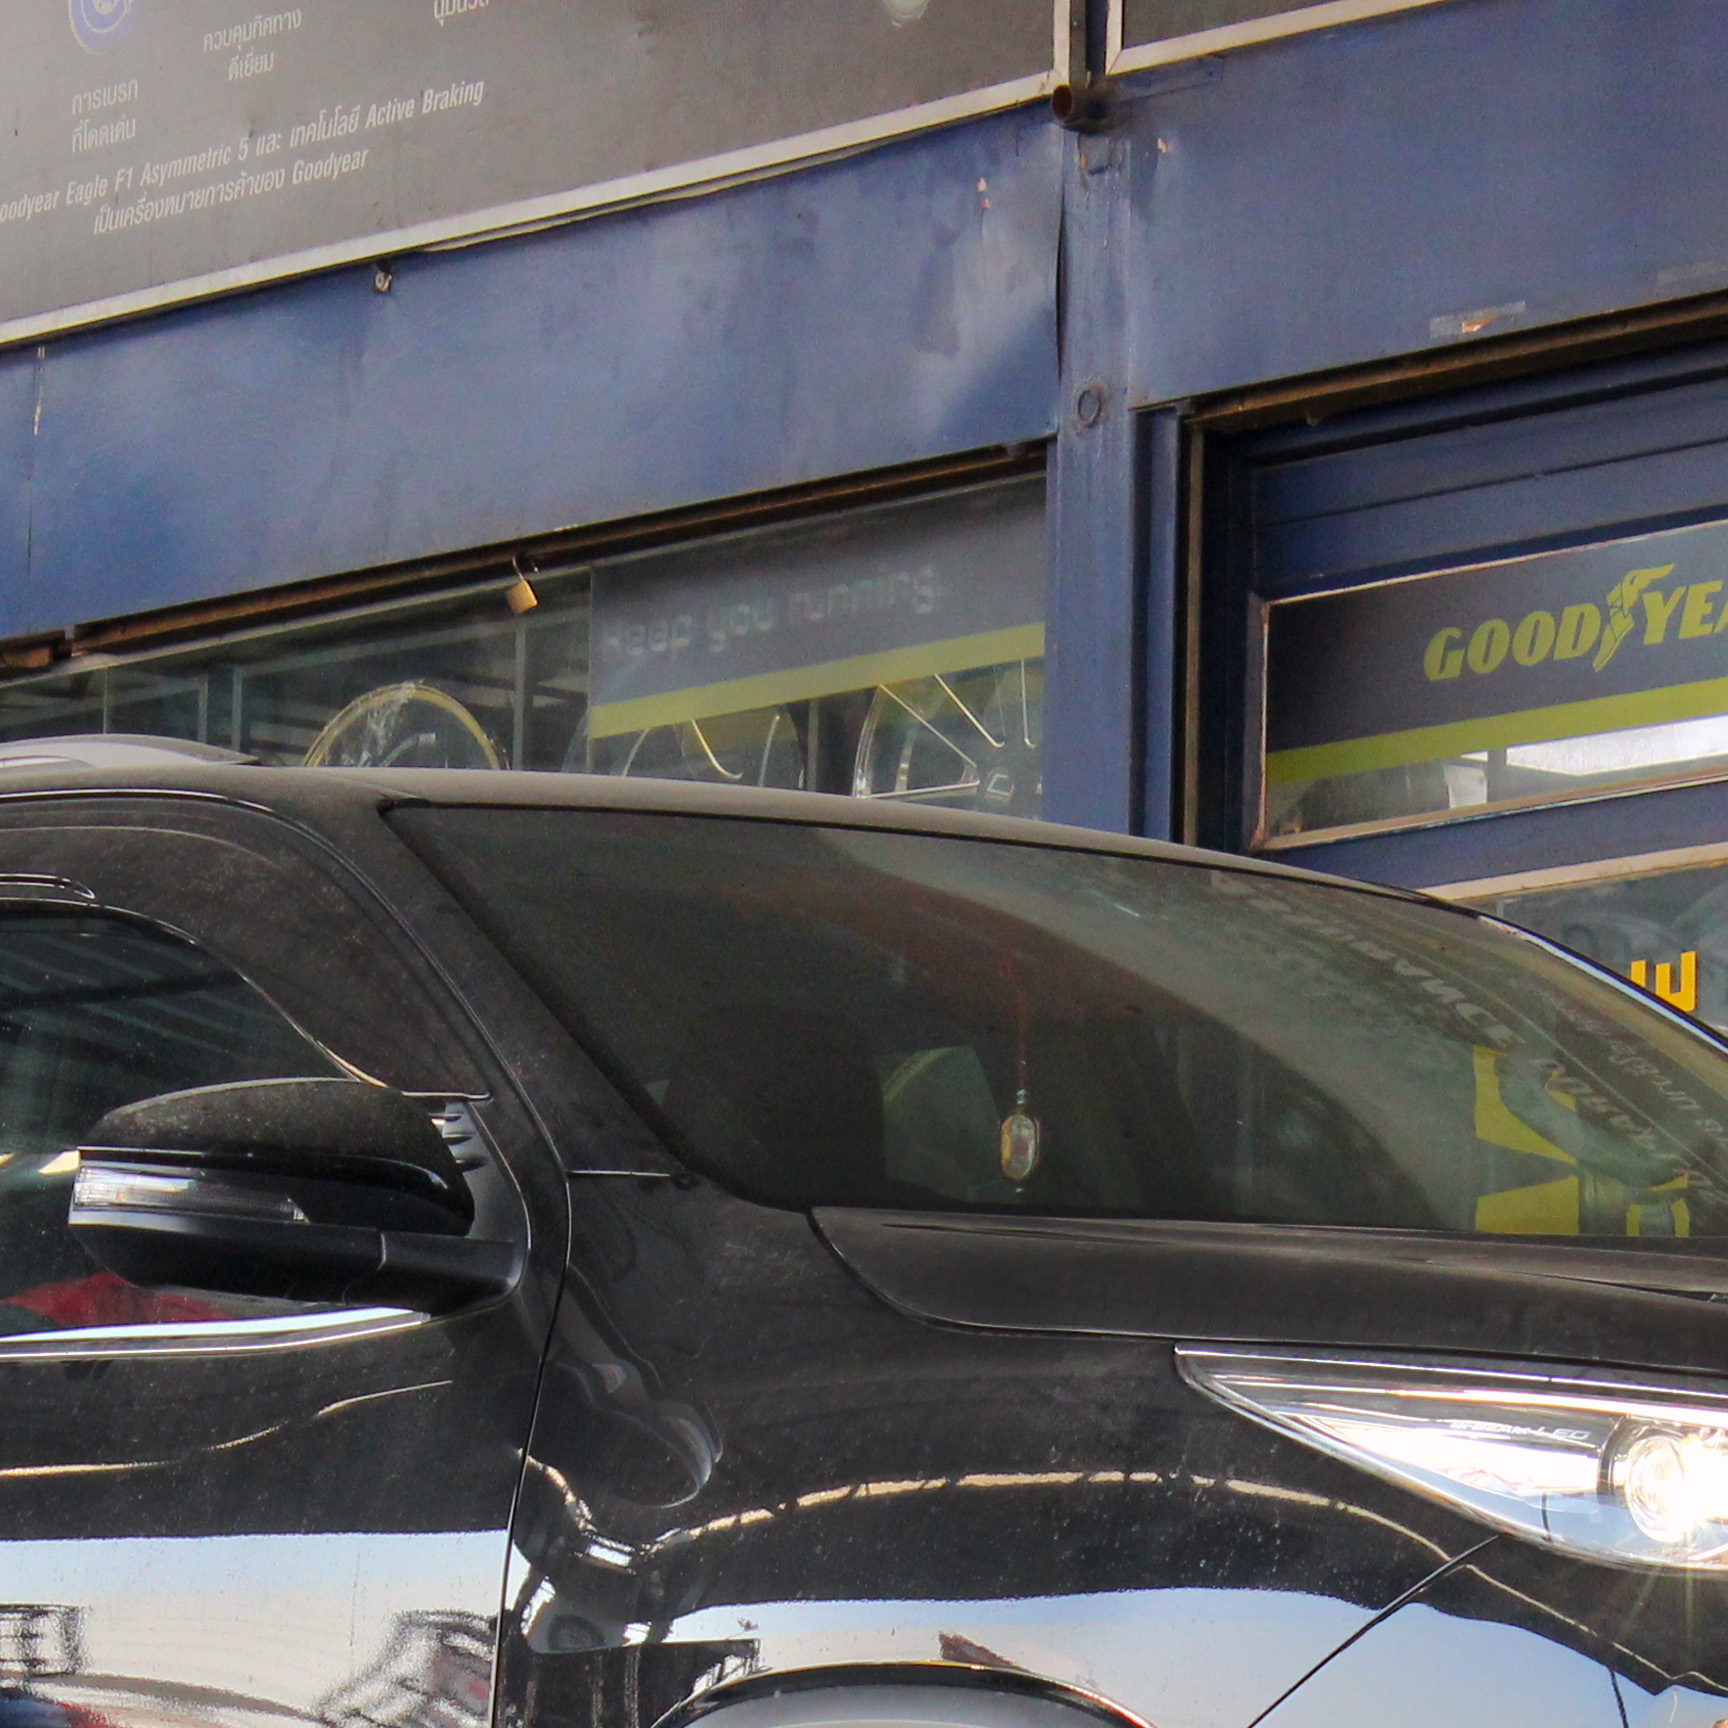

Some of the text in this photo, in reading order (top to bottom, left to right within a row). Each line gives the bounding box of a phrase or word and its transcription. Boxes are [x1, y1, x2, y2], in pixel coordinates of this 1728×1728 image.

[65, 175, 108, 207] Eagle
[114, 167, 134, 193] F1
[140, 142, 233, 190] Asymmetric
[237, 135, 250, 158] 5
[253, 130, 282, 155] และ
[365, 96, 416, 129] Active
[420, 79, 486, 116] Braking
[291, 147, 369, 187] Goodyear
